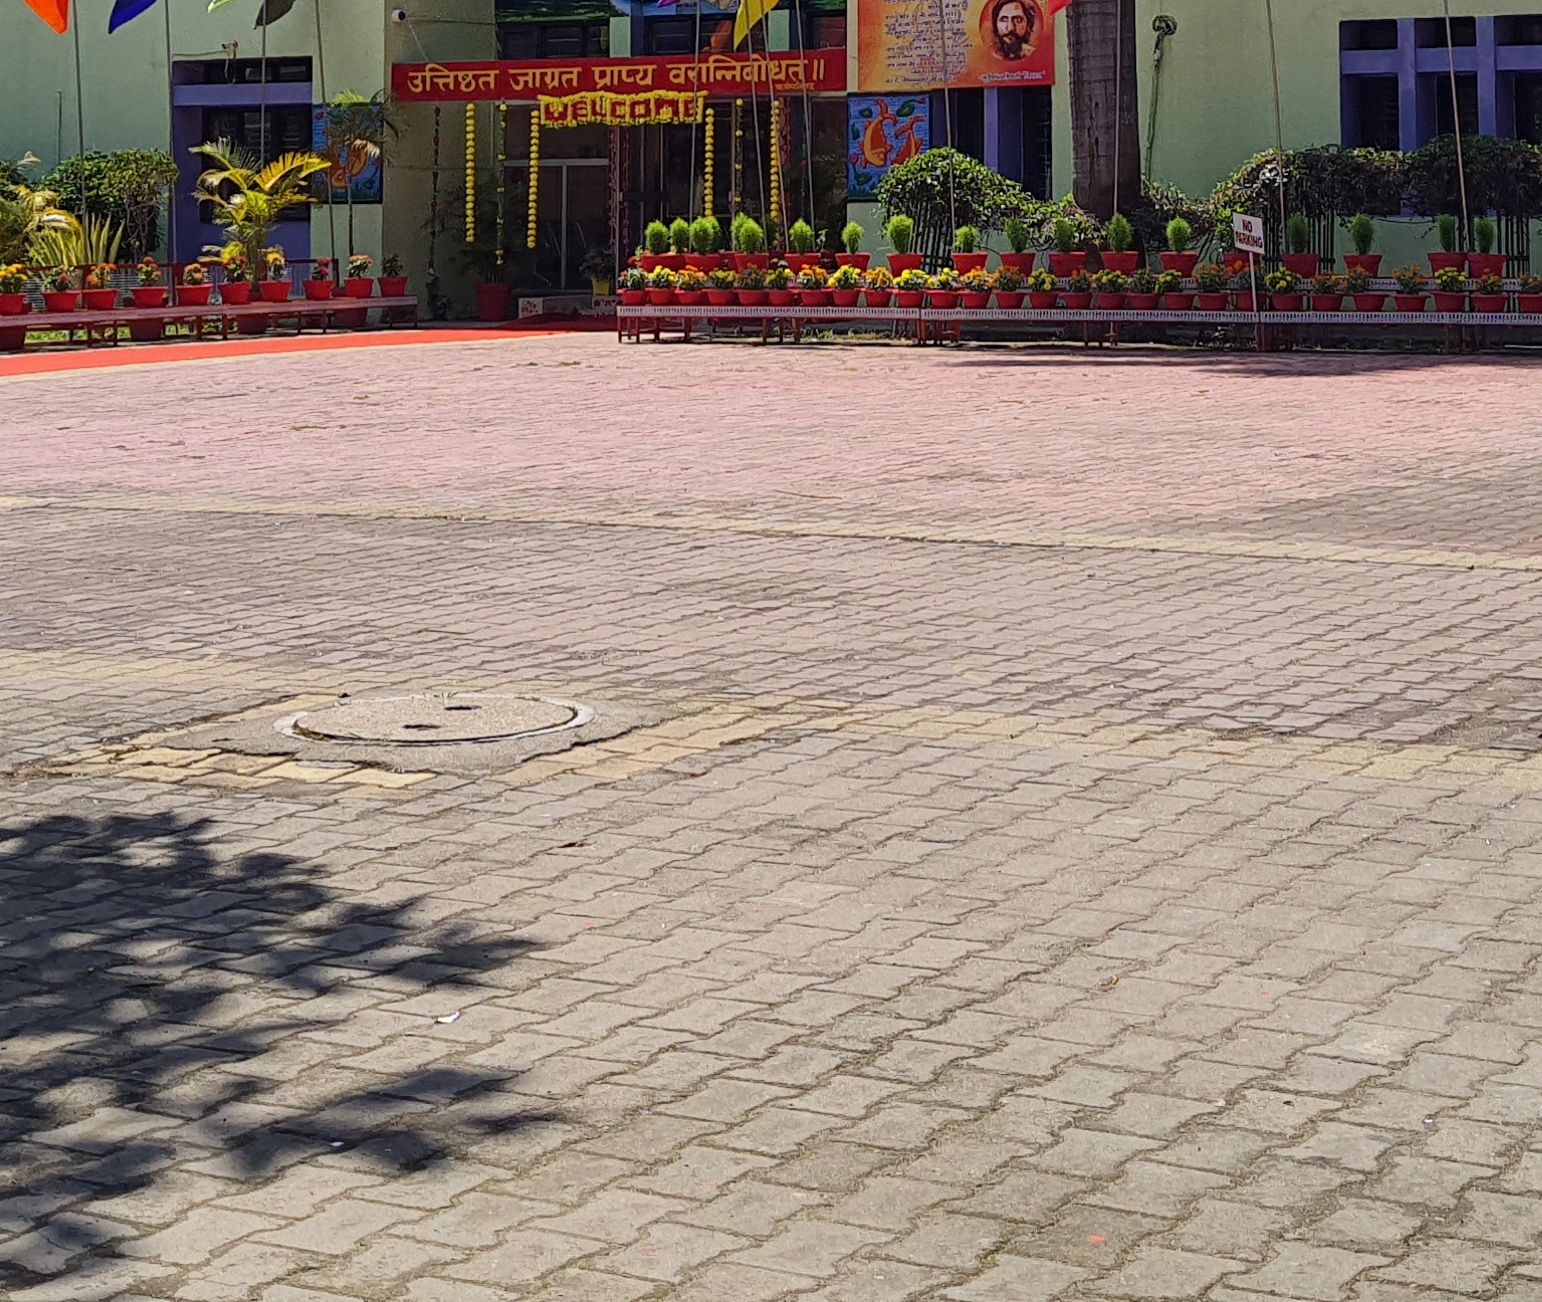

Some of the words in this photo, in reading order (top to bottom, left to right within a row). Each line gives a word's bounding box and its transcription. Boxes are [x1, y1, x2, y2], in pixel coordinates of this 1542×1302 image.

[407, 63, 500, 93] उत्तिष्ठत
[508, 67, 582, 91] जाग्रत
[592, 64, 657, 88] प्राप्य
[1242, 219, 1253, 233] NO
